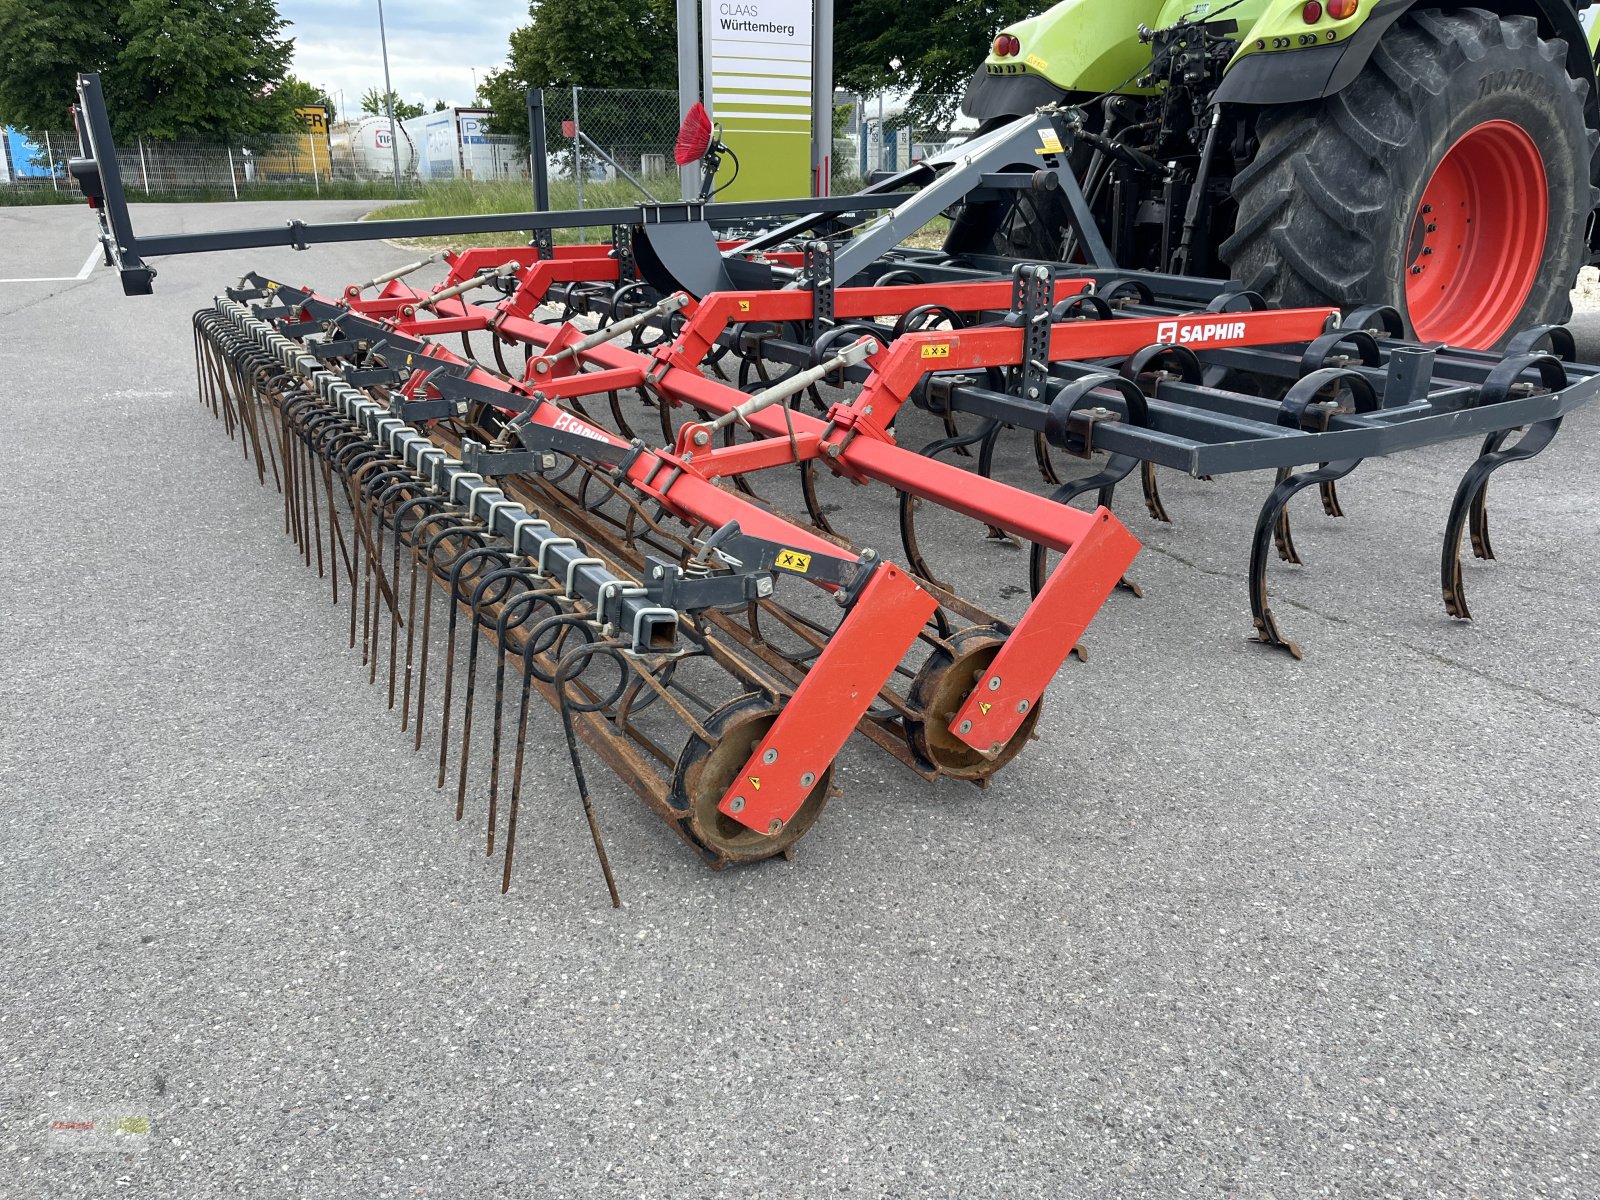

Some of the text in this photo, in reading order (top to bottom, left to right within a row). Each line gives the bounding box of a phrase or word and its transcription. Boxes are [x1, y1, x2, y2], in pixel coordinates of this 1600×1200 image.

[719, 3, 758, 17] CLAAS
[720, 18, 795, 37] Württemberg
[1179, 322, 1245, 342] SAPHIR
